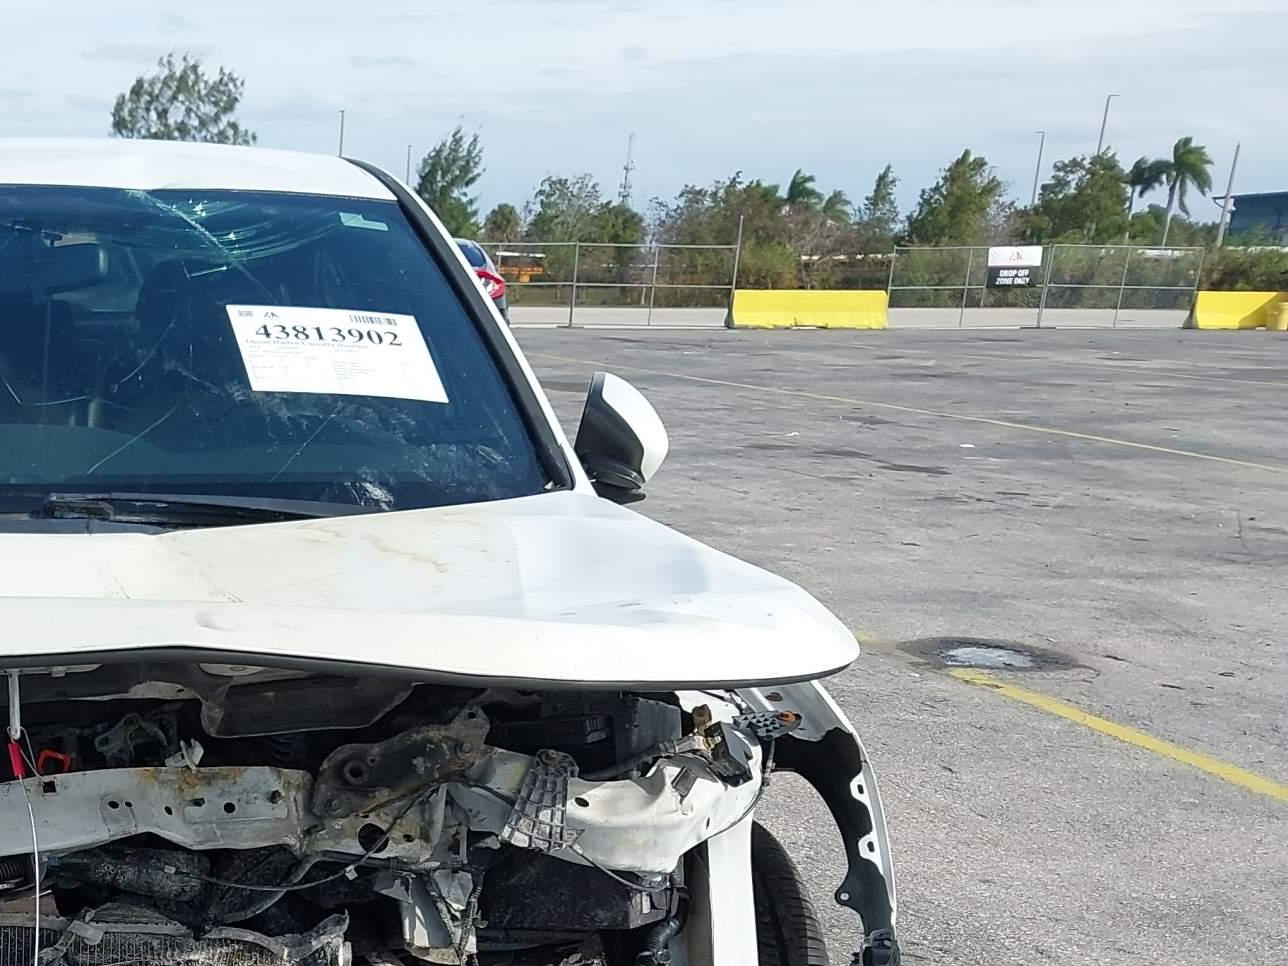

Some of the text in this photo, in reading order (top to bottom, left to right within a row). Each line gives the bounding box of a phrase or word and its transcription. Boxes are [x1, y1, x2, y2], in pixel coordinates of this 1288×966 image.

[1000, 269, 1029, 277] DROP OFF
[996, 277, 1030, 285] ZONE ONLY
[255, 324, 403, 346] 43813902
